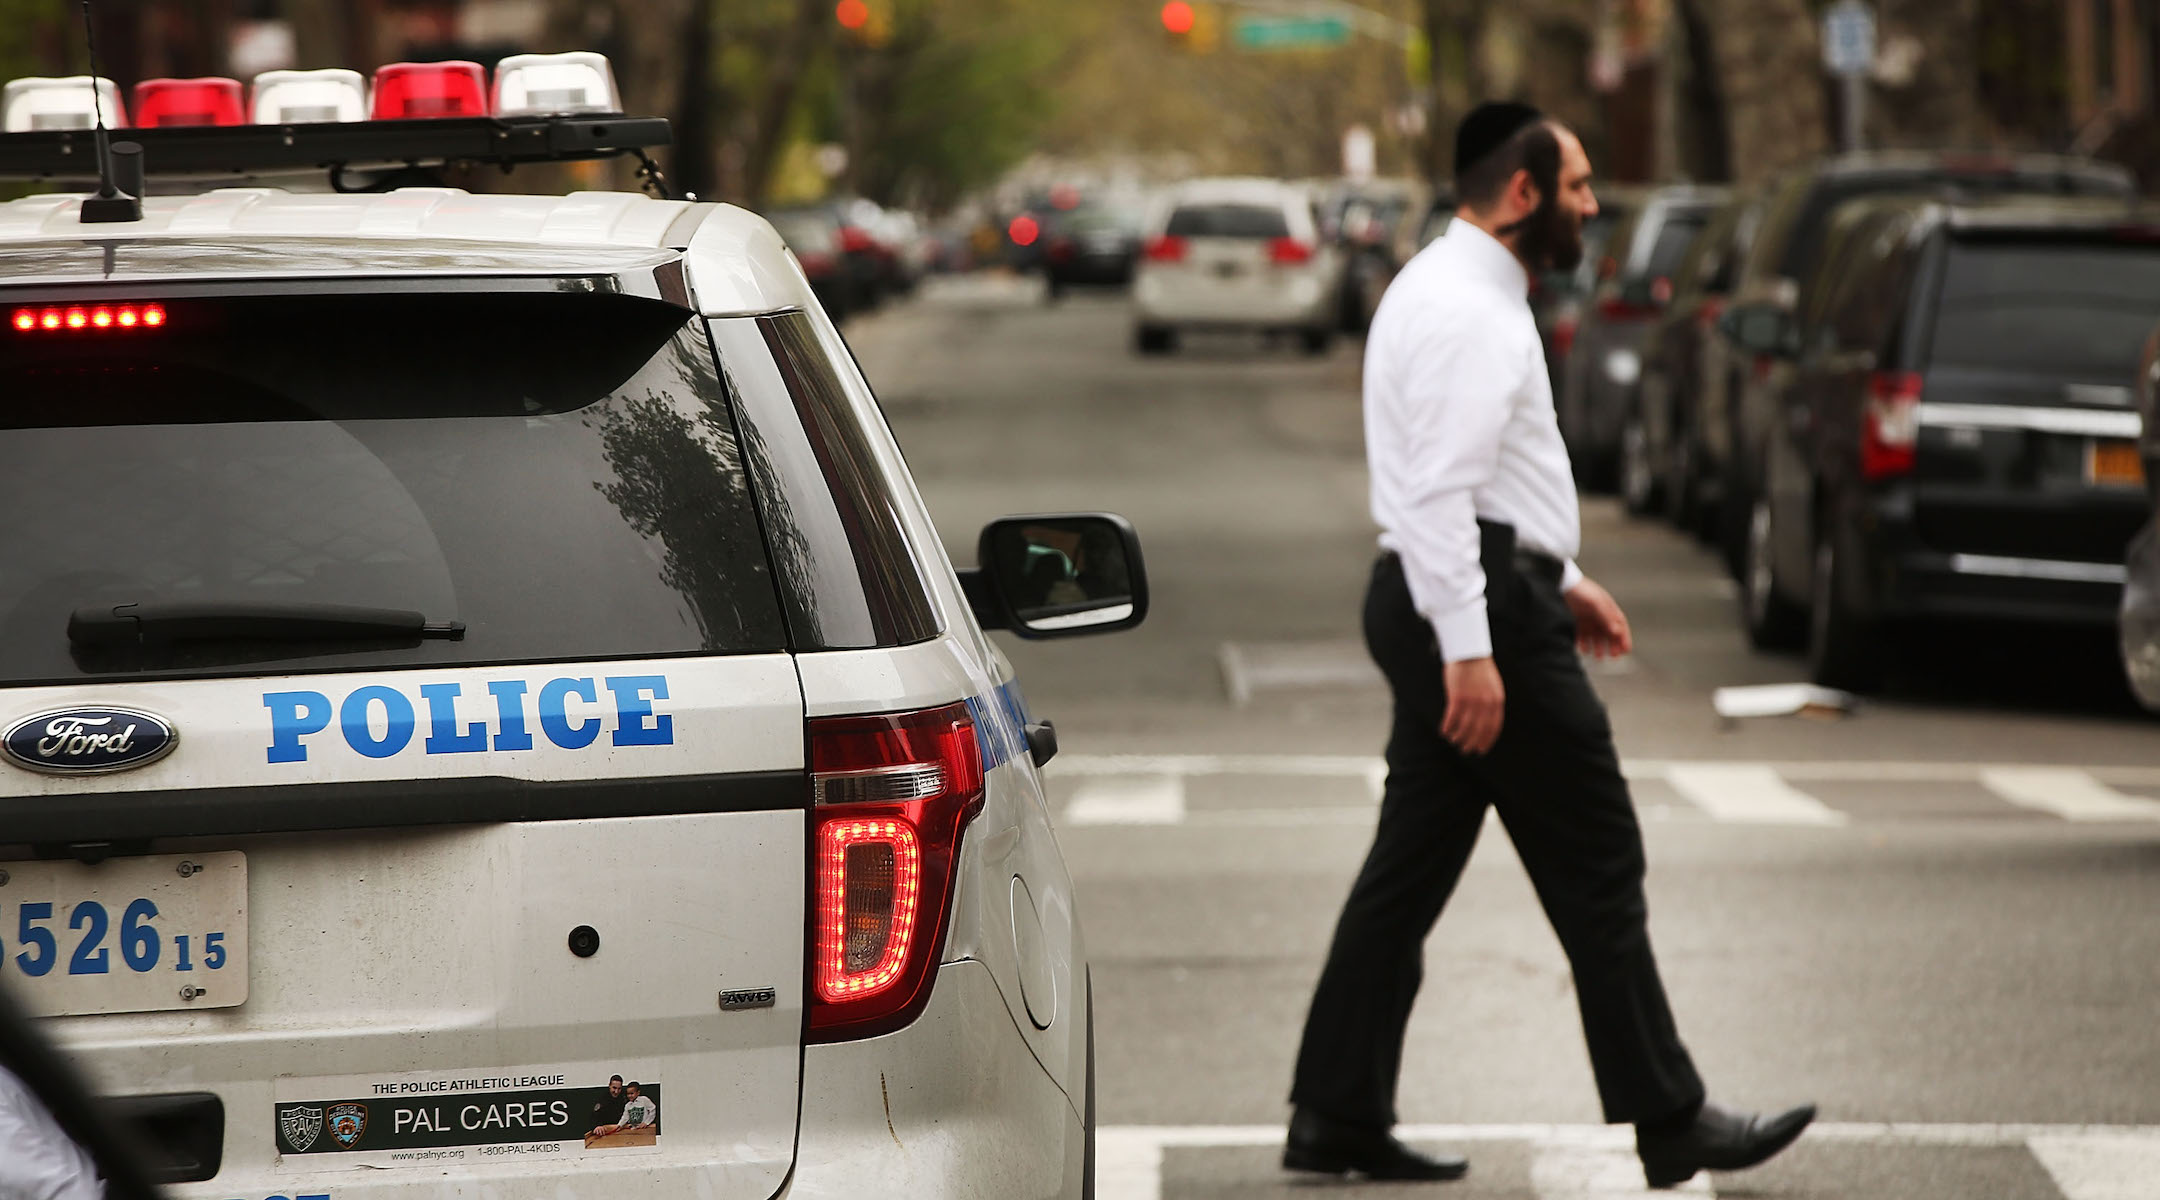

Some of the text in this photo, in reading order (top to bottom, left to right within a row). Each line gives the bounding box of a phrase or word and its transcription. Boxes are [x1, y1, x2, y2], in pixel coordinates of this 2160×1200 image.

[262, 675, 674, 764] POLICE
[38, 716, 137, 758] Ford
[0, 898, 227, 977] 526 15
[724, 991, 772, 1005] AWD
[371, 1074, 565, 1094] THE POLICE ATHLETIC LEAGUE
[291, 1117, 312, 1136] PAL
[394, 1101, 569, 1134] PAL CARES
[391, 1143, 561, 1161] www.palnyc.org 1-800-PAL-4KIDS
